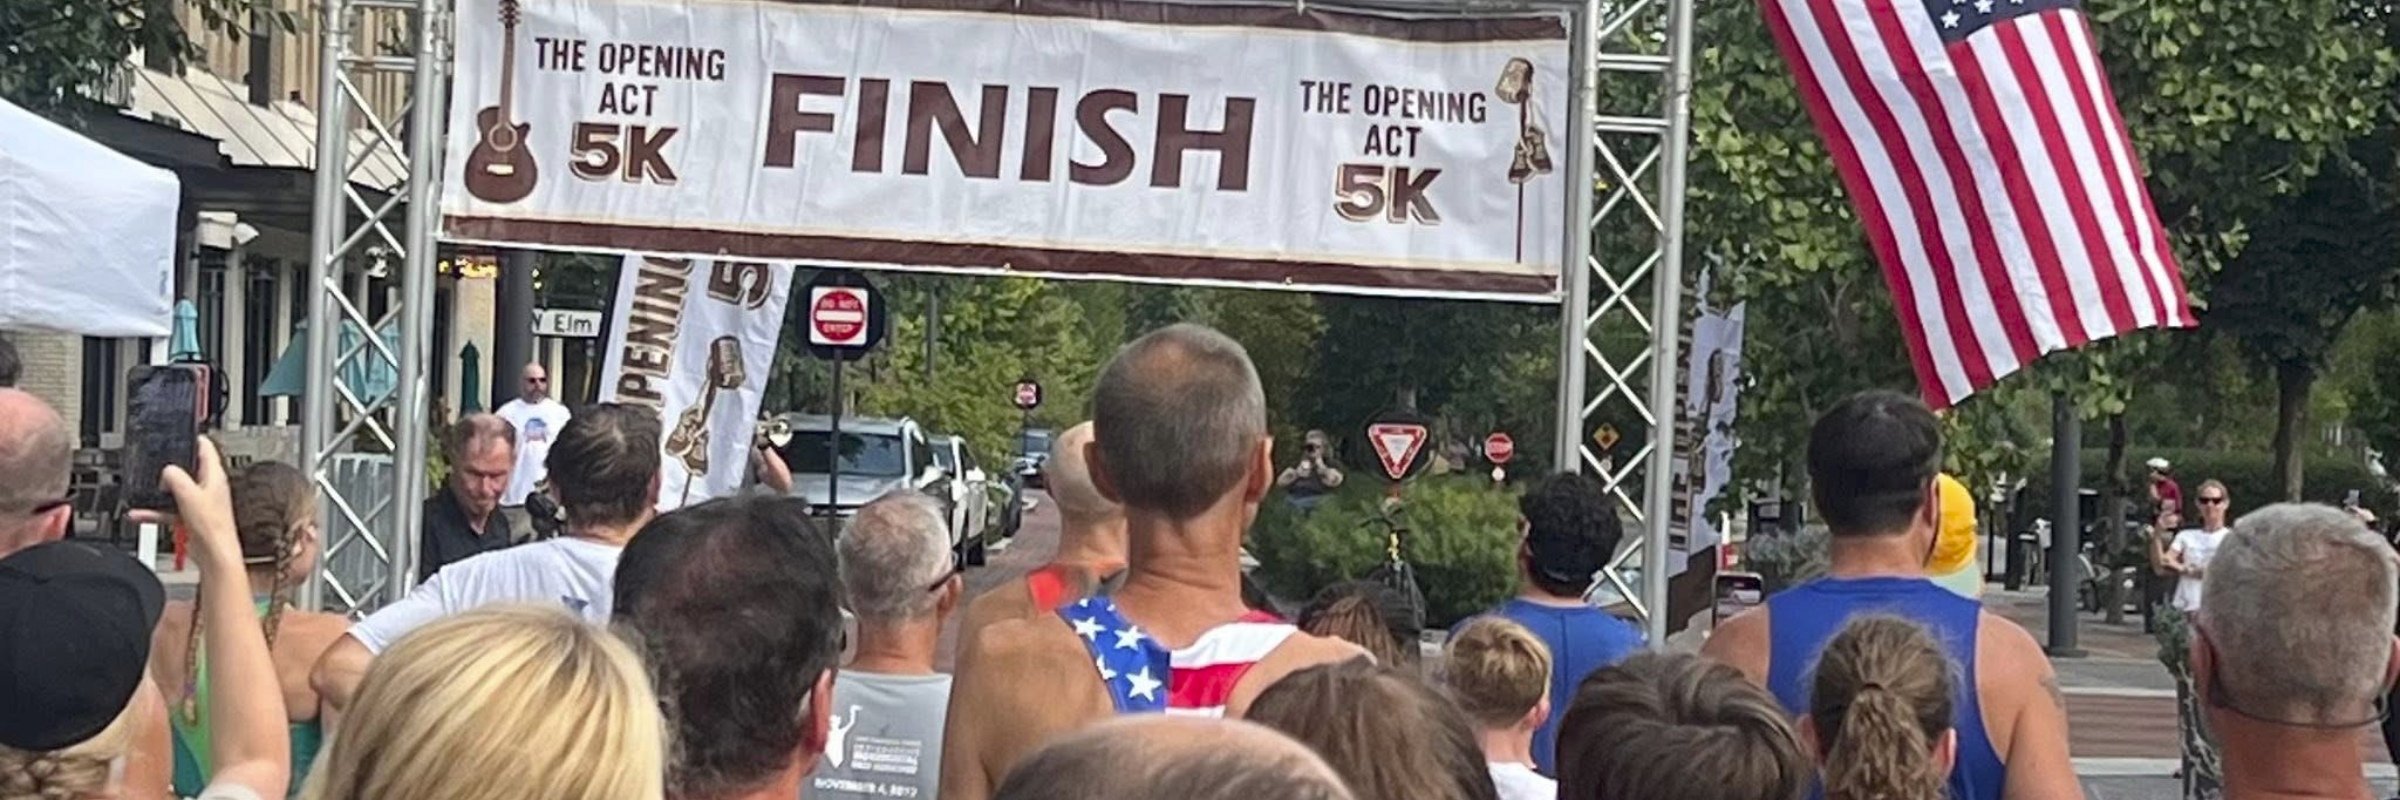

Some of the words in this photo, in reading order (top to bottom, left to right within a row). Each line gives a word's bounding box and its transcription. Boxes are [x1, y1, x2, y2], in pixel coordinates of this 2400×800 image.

[535, 37, 587, 72] THE
[598, 42, 725, 81] OPENING
[598, 82, 659, 116] ACT
[1300, 79, 1352, 114] THE
[1363, 84, 1487, 123] OPENING
[568, 121, 679, 186] 5K
[763, 72, 1256, 192] FINISH
[1363, 124, 1422, 158] ACT
[1333, 163, 1442, 226] 5K
[707, 259, 774, 310] 5
[553, 314, 593, 333] Elm
[616, 255, 695, 404] PENIN
